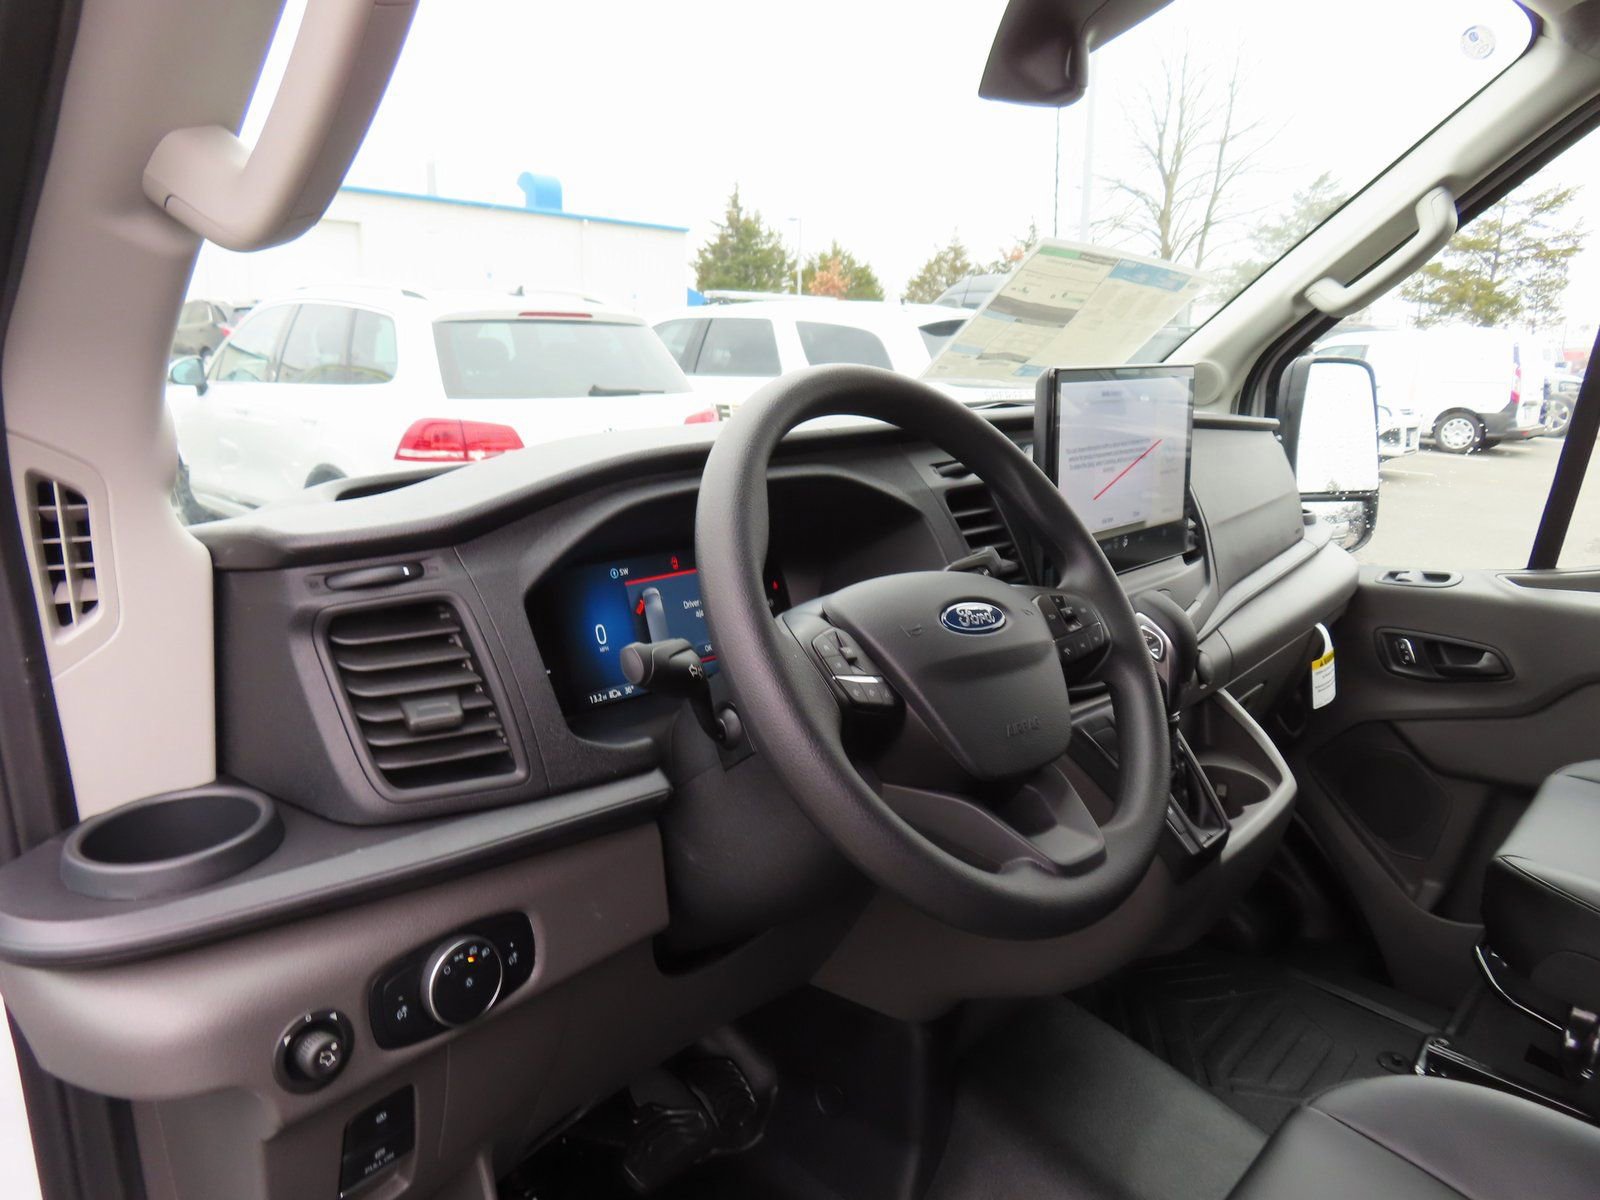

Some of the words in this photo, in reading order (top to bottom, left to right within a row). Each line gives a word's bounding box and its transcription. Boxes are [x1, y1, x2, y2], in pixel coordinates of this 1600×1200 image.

[619, 568, 629, 576] SW
[683, 600, 699, 609] Driver
[956, 606, 996, 627] Ford
[595, 624, 607, 645] 0
[705, 644, 712, 652] OK
